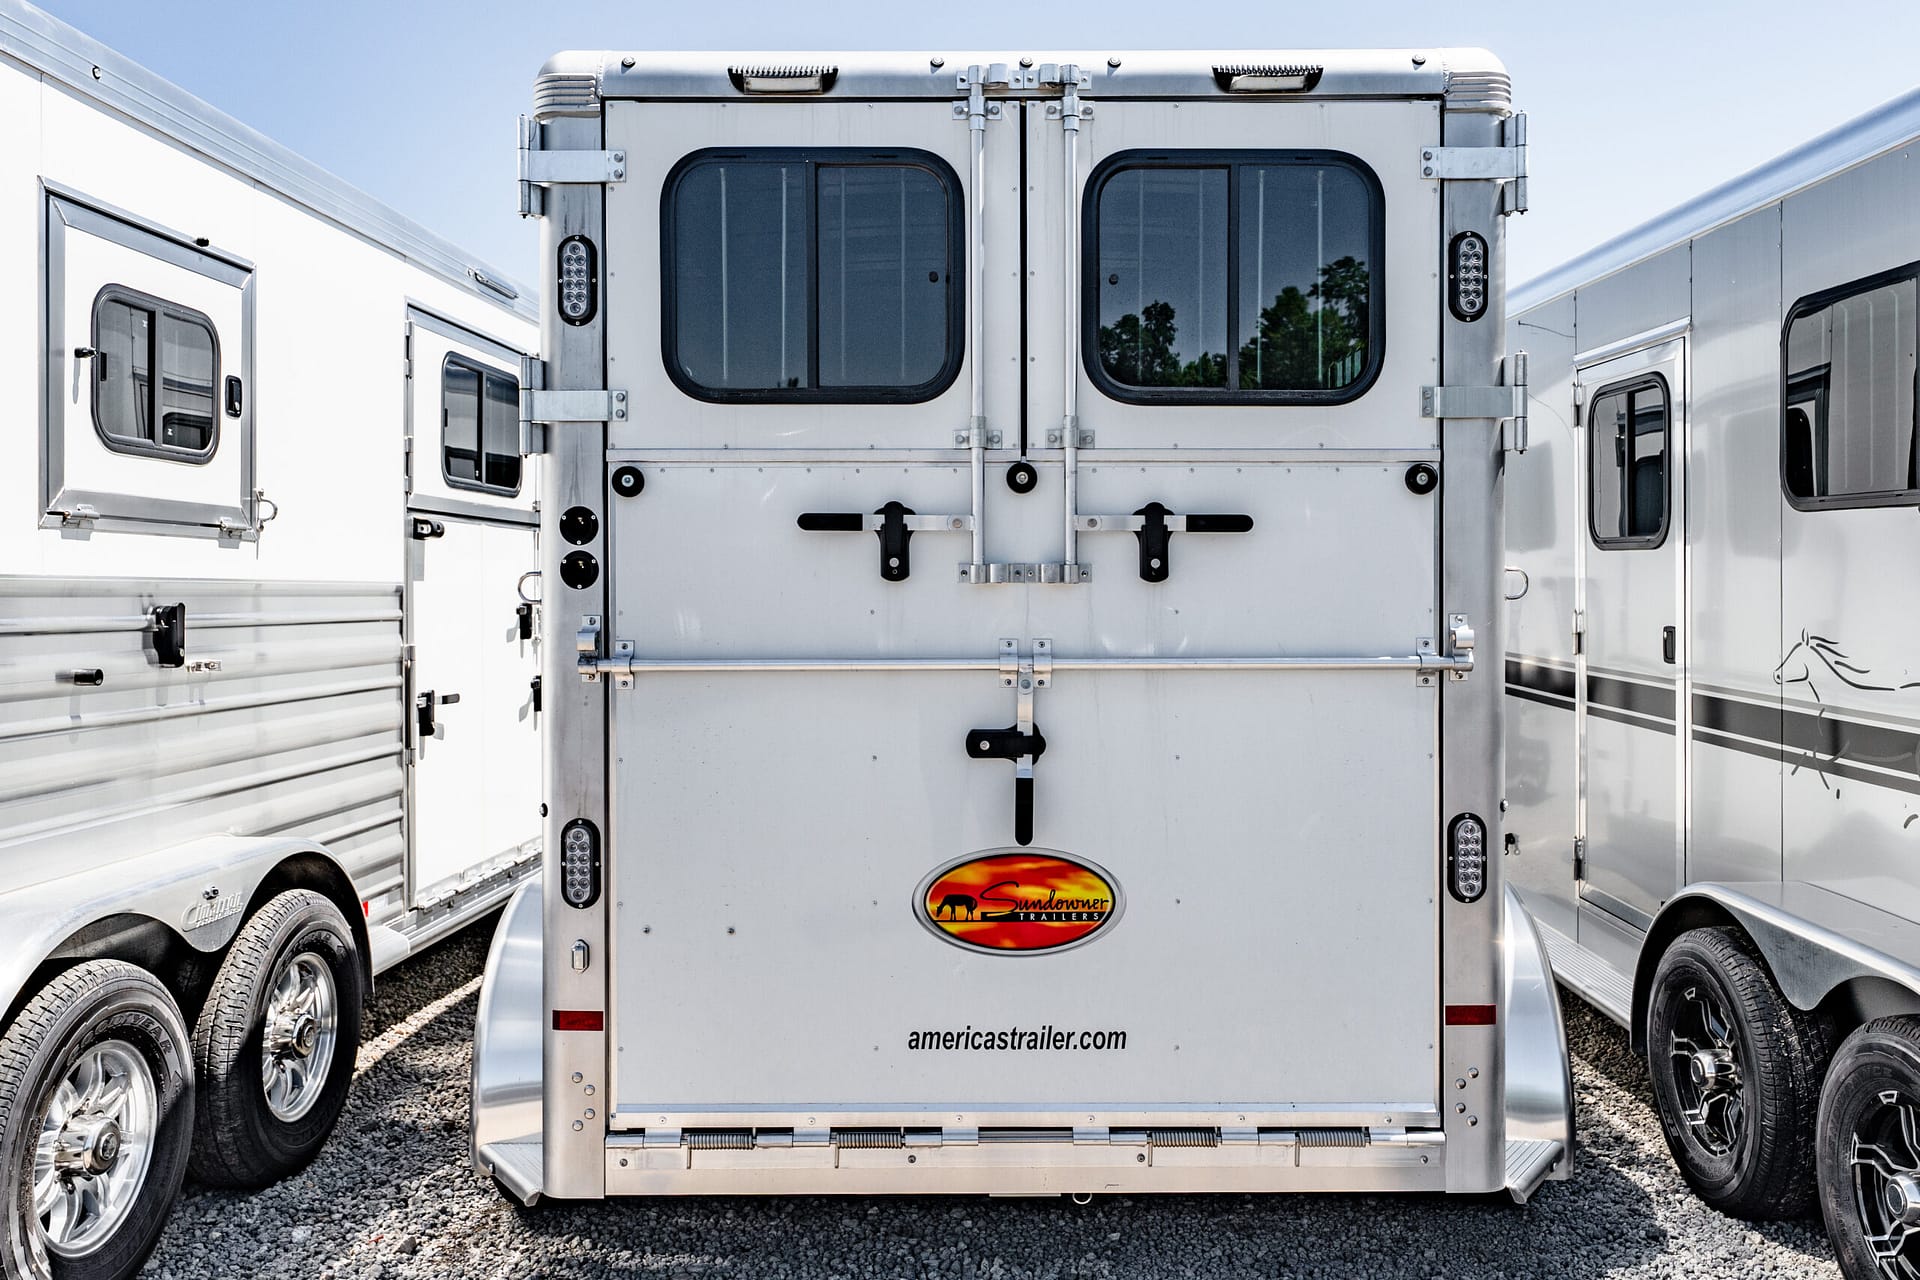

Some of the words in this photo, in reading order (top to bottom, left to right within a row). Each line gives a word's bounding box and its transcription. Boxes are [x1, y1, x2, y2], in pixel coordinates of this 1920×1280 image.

[979, 881, 1110, 915] Sundowner
[1019, 912, 1100, 921] TRAILERS
[908, 1025, 1127, 1050] americastrailer.com
